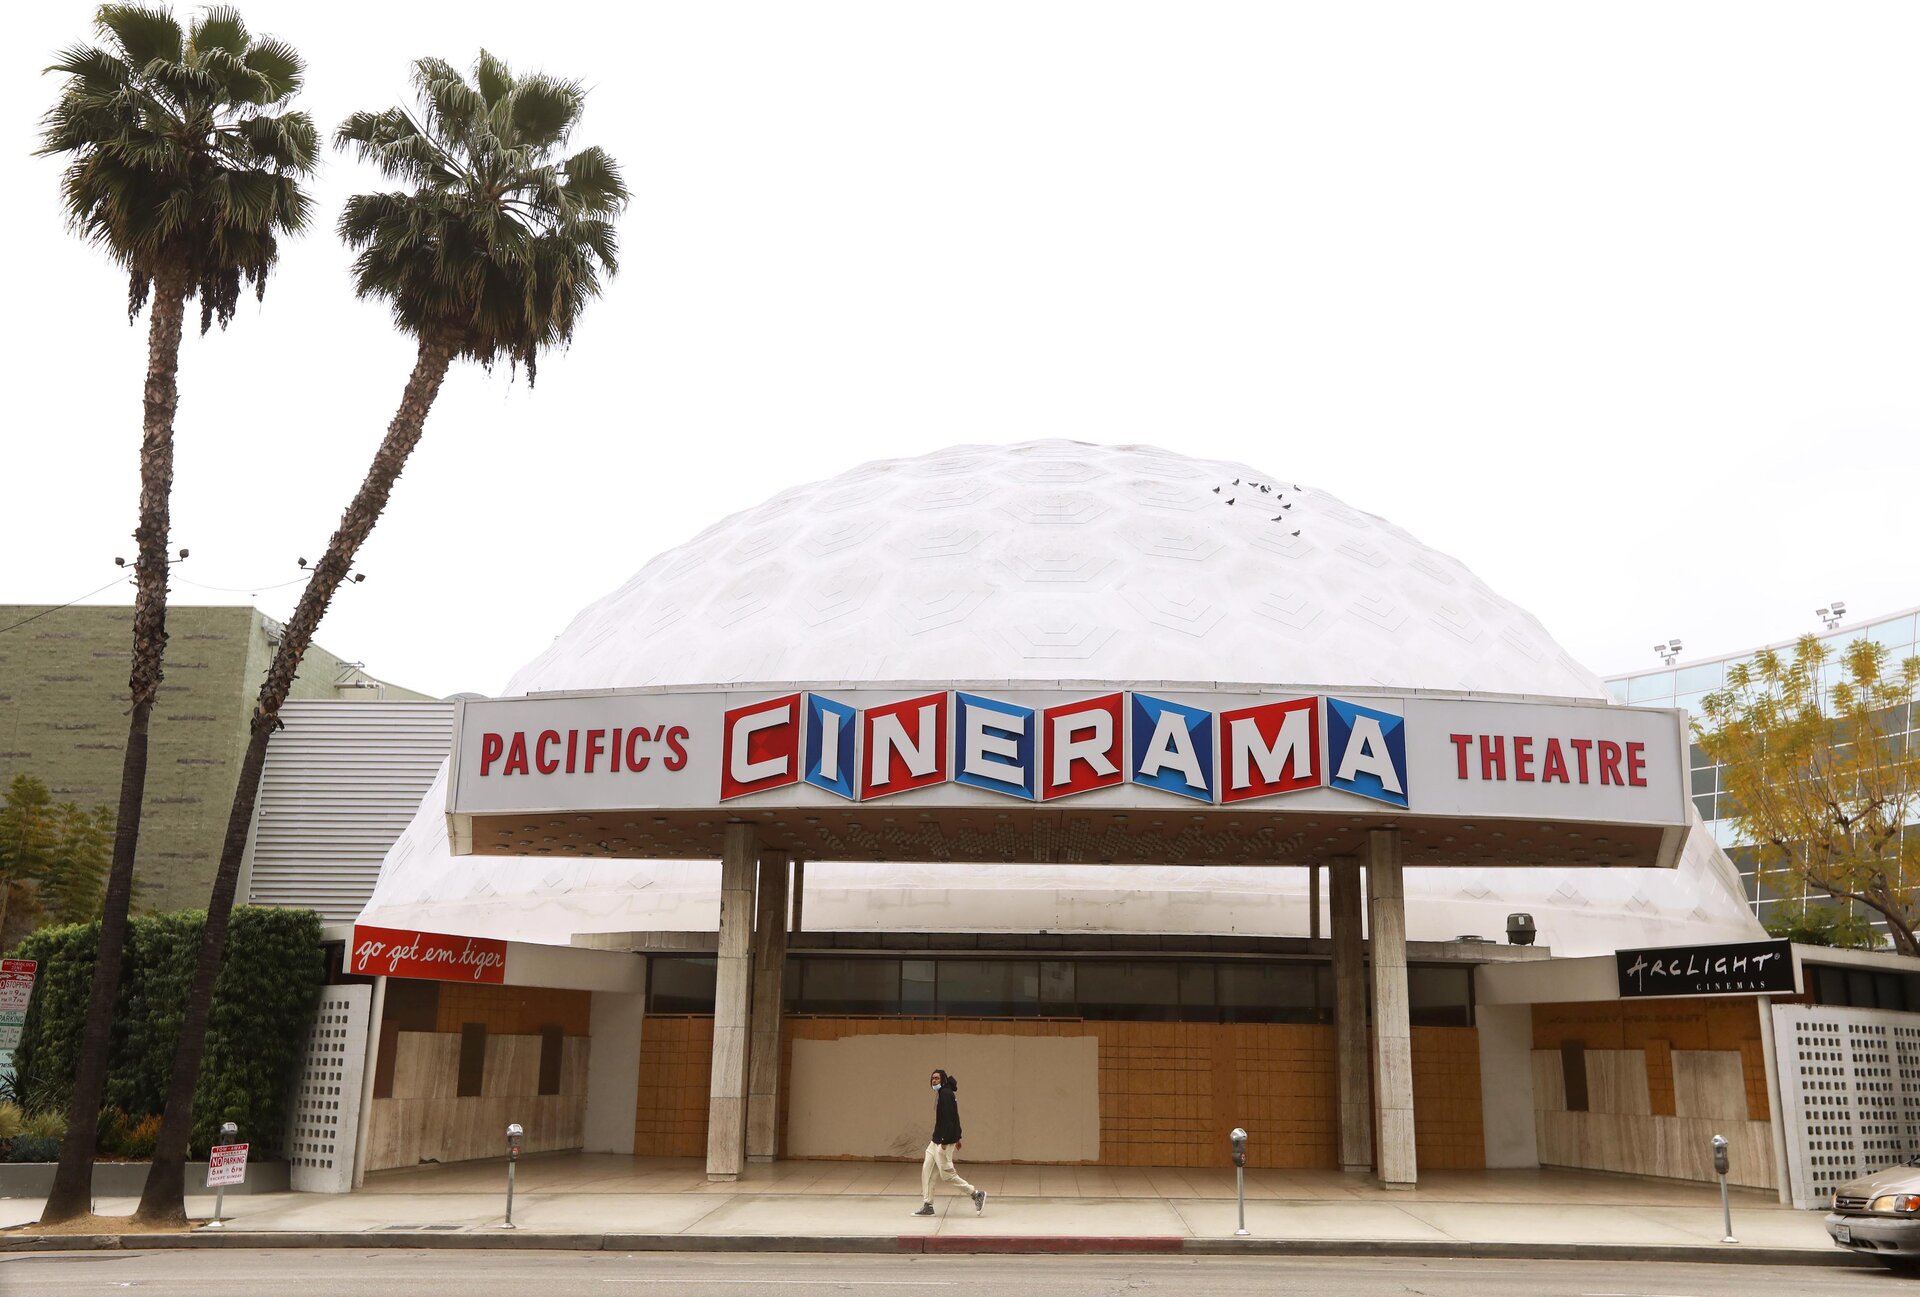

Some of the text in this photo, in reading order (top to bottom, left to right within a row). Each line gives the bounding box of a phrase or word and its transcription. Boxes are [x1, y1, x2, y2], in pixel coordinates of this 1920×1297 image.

[479, 702, 1648, 795] PACIFIC'S CINERAMA THEATRE
[355, 933, 504, 980] go get em tiger
[6, 980, 32, 989] STOPPING
[1696, 980, 1766, 991] CINEMAS
[211, 1156, 244, 1166] NO PARKING
